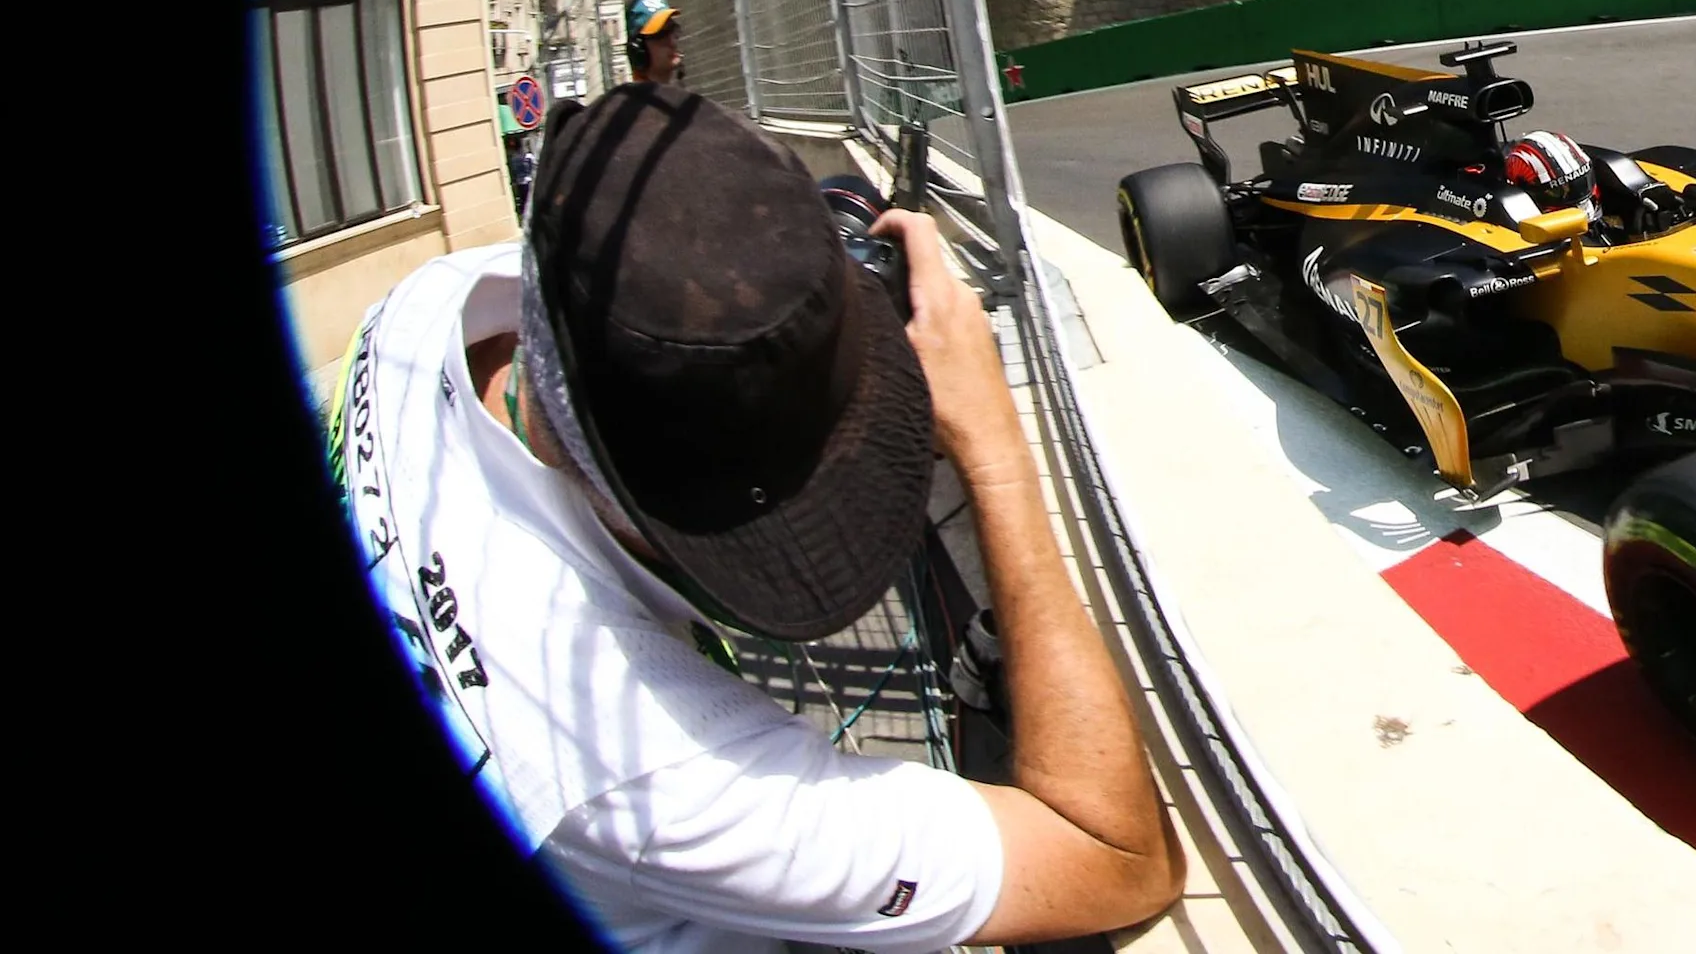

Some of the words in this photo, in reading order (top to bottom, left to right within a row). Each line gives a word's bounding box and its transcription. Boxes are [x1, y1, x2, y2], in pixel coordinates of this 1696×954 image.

[1305, 62, 1337, 94] HUL
[1427, 89, 1469, 109] MAPFRE
[1356, 135, 1421, 163] INFINITI
[1550, 163, 1592, 189] RENAULT
[1469, 286, 1490, 298] Bell
[1508, 275, 1535, 288] Ross
[1356, 290, 1384, 340] 27
[418, 550, 490, 691] 2017
